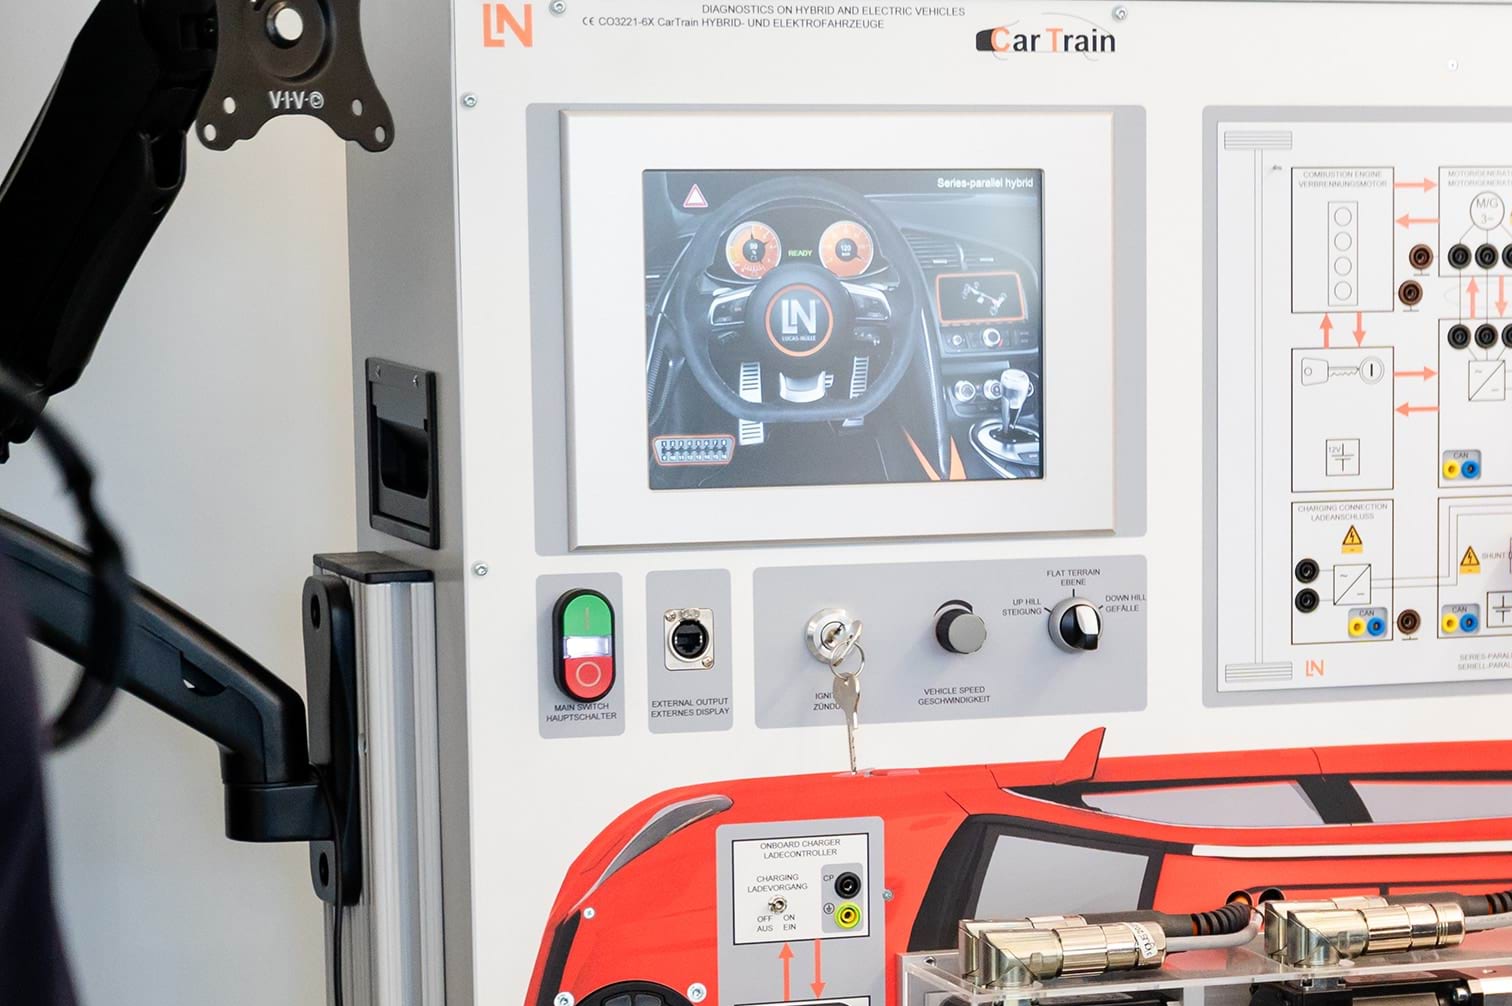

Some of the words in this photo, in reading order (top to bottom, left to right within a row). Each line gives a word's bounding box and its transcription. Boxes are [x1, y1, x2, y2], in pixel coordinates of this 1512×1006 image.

[702, 4, 775, 15] DIAGNOSTICS
[777, 5, 793, 15] ON
[795, 5, 835, 16] HYBRID
[837, 6, 860, 16] AND
[862, 6, 912, 16] ELECTRIC
[915, 7, 966, 17] VEHICLES
[483, 3, 533, 48] LN
[598, 17, 656, 27] CO3221-6X
[657, 17, 699, 27] CarTrain
[701, 18, 745, 28] HYBRID-
[747, 19, 770, 28] UND
[773, 19, 885, 29] ELEKTROFAHRZEUGE
[990, 26, 1040, 53] Car
[1046, 28, 1116, 53] Train
[1354, 169, 1383, 177] ENGINE
[937, 177, 1003, 189] Series-parallel
[1005, 177, 1033, 188] hybrid
[1476, 198, 1499, 210] M/G
[1453, 451, 1469, 459] CAN
[1297, 504, 1338, 513] CHARGING
[1338, 502, 1388, 511] CONNECTION
[1310, 513, 1375, 521] LADEANSCHLUSS
[1481, 552, 1506, 560] SHUNT
[1046, 569, 1066, 578] FLAT
[1067, 568, 1101, 577] TERRAIN
[1060, 578, 1087, 587] EBENE
[1012, 599, 1024, 607] UP
[1025, 598, 1042, 606] HILL
[1105, 594, 1129, 603] DOWN
[1130, 593, 1147, 602] HILL
[1001, 607, 1042, 617] STEIGUNG
[1105, 602, 1139, 613] GEFÄLLE
[1452, 606, 1468, 614] CAN
[1359, 609, 1375, 617] CAN
[923, 687, 958, 697] VEHICLE
[959, 685, 986, 694] SPEED
[814, 692, 832, 702] IGNI
[918, 695, 991, 706] GESCHWINDIGKEIT
[554, 703, 575, 713] MAIN
[576, 702, 609, 711] SWITCH
[651, 699, 694, 709] EXTERNAL
[695, 696, 729, 706] OUTPUT
[812, 702, 840, 712] ZÜNDU
[545, 711, 617, 723] HAUPTSCHALTER
[651, 708, 695, 719] EXTERNES
[695, 706, 731, 717] DISPLAY
[760, 840, 800, 851] ONBOARD
[801, 838, 841, 849] CHARGER
[764, 848, 838, 860] LADECONTROLLER
[756, 873, 800, 883] CHARGING
[822, 874, 835, 883] CP
[747, 882, 809, 893] LADEVORGANG
[756, 914, 774, 924] OFF
[783, 913, 796, 922] ON
[756, 924, 774, 933] AUS
[783, 923, 797, 932] EIN
